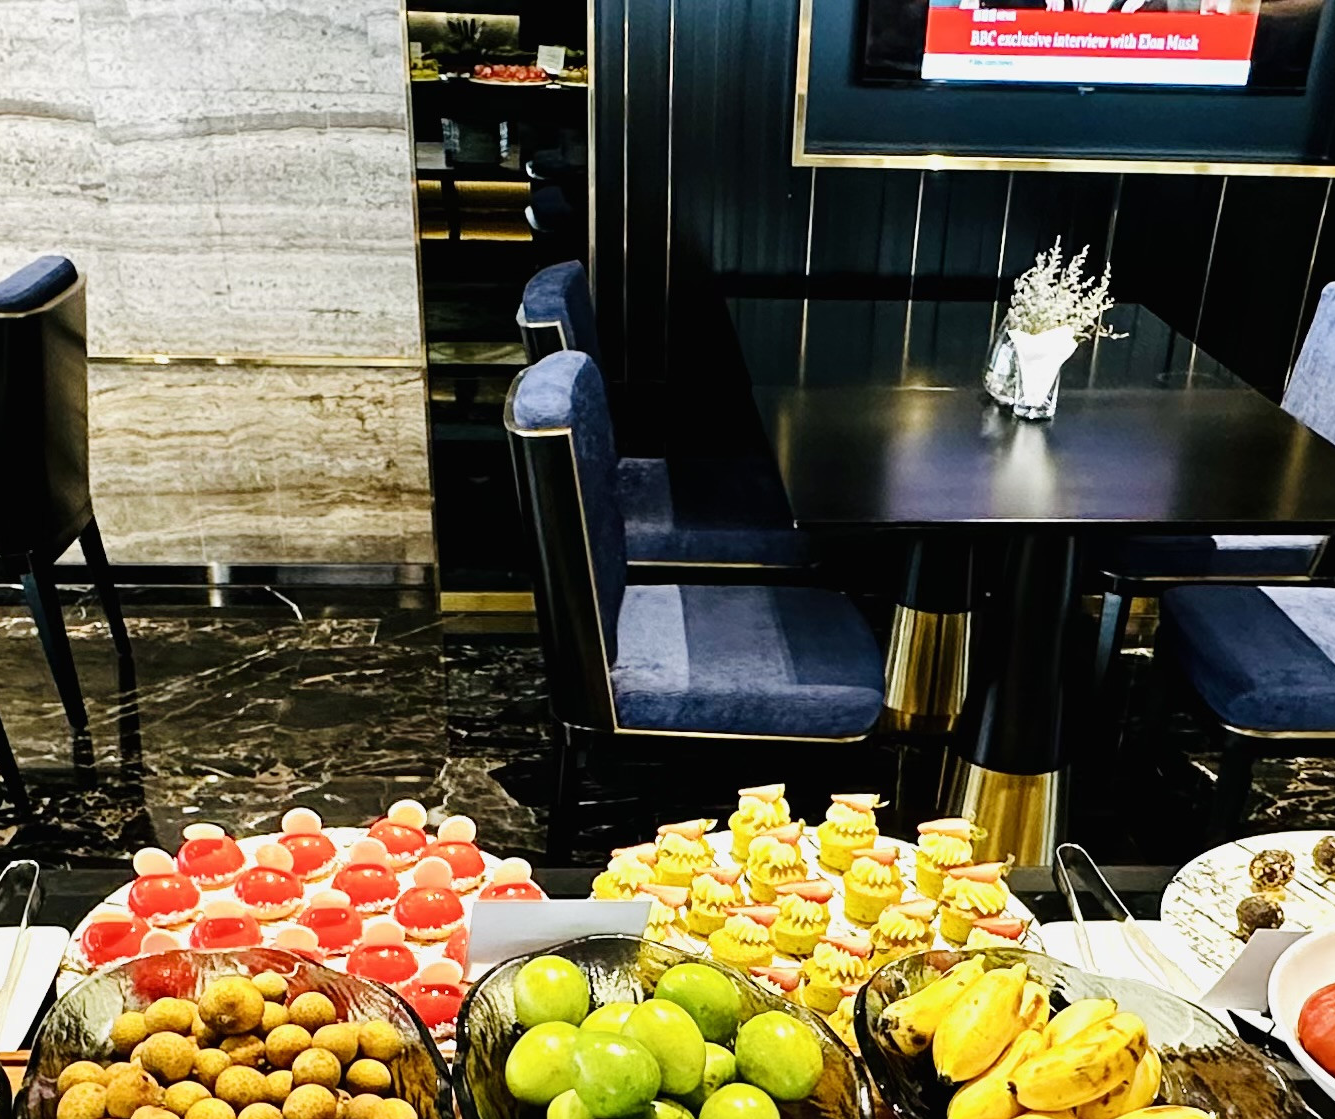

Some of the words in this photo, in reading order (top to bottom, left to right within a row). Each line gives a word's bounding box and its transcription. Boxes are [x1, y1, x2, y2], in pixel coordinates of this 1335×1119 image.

[970, 29, 997, 47] BBC
[997, 30, 1052, 48] exclusive
[1052, 31, 1109, 49] interview
[1110, 33, 1137, 50] with
[1138, 33, 1165, 50] Elon
[1166, 34, 1199, 51] Musk
